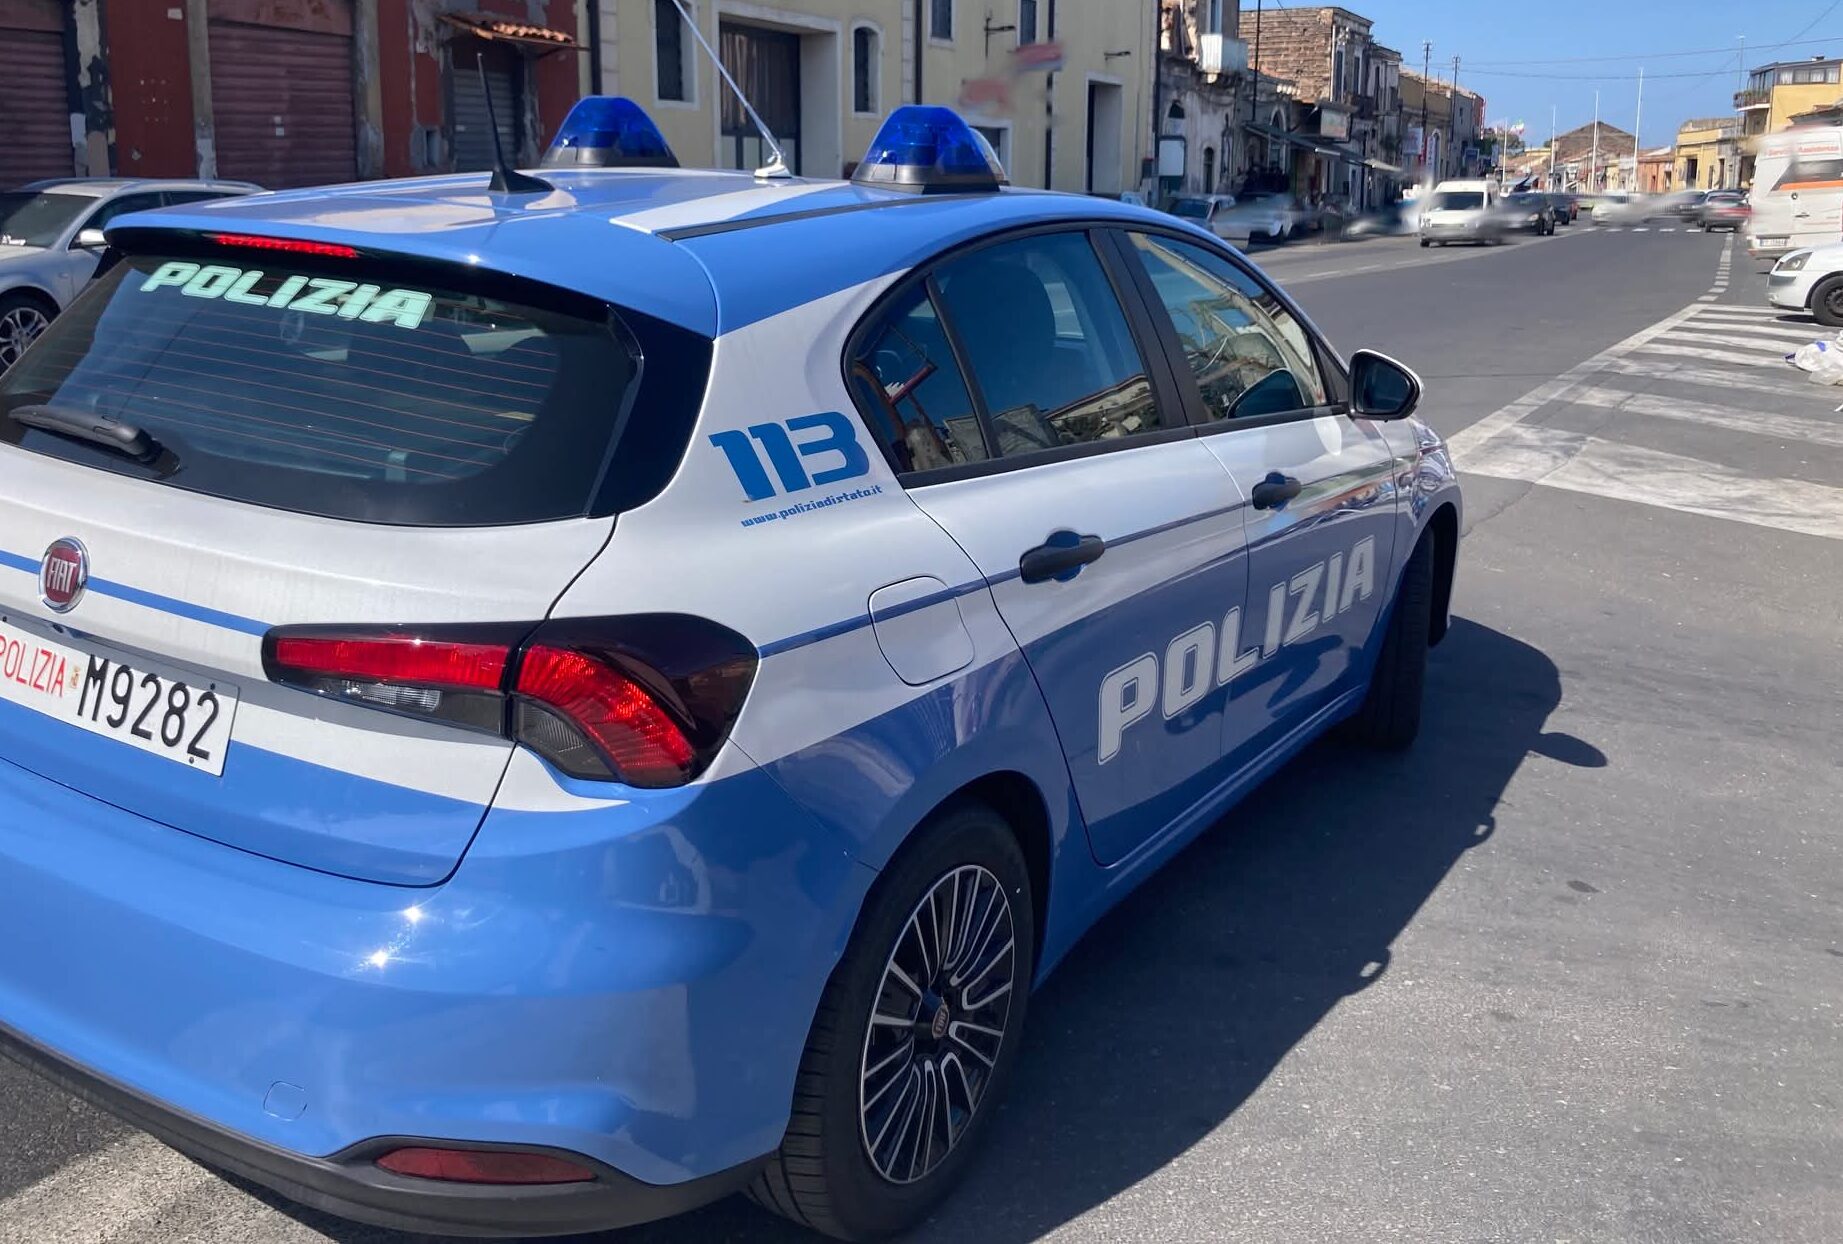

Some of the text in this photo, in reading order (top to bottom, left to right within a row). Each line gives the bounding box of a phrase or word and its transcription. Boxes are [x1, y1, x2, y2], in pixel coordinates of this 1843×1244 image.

[140, 261, 433, 330] POLIZIA
[708, 411, 870, 502] 113
[46, 556, 79, 594] FIAT
[1097, 534, 1376, 766] POLIZIA
[77, 654, 220, 760] M9282
